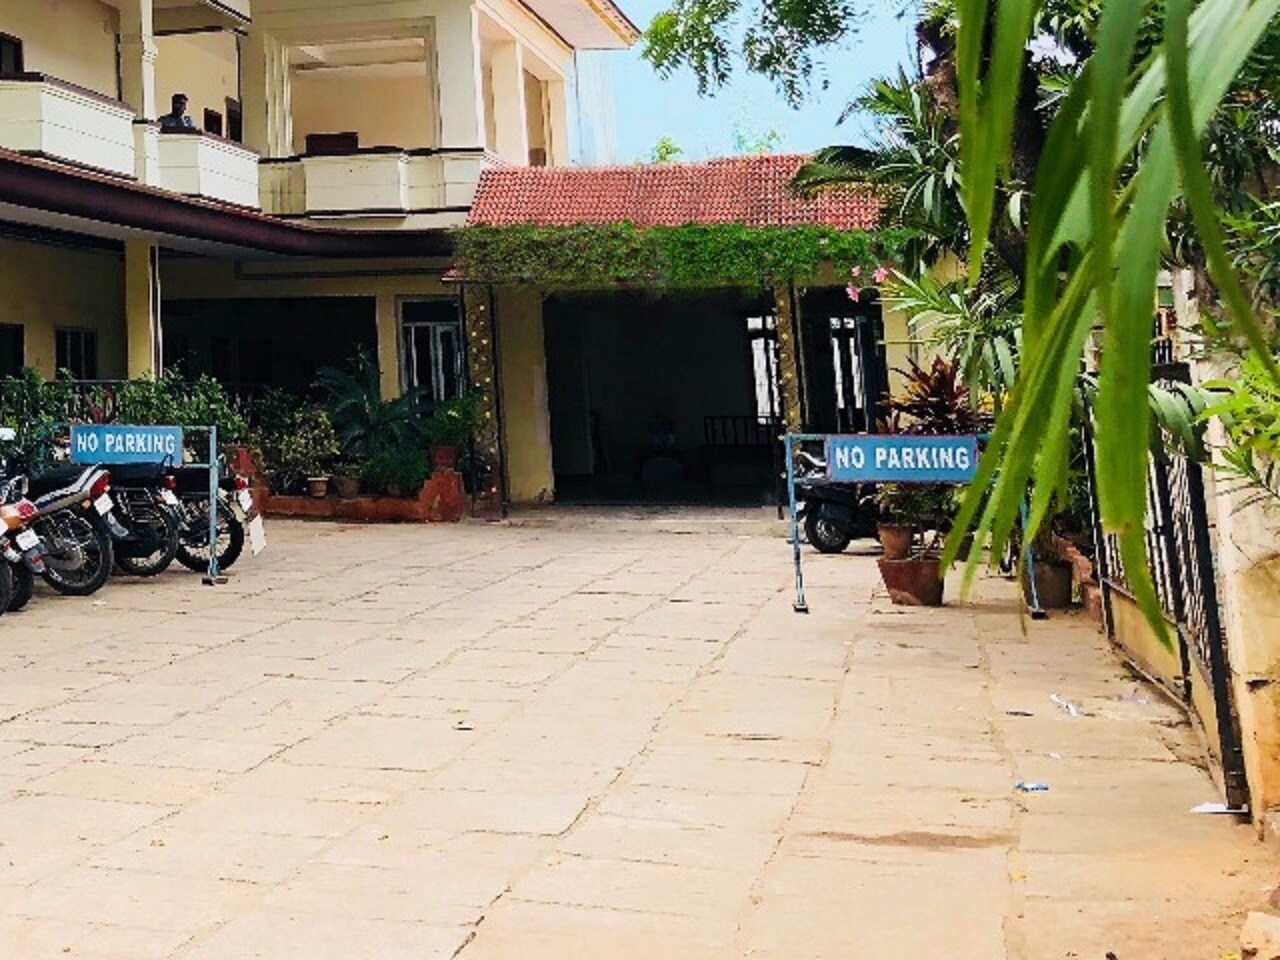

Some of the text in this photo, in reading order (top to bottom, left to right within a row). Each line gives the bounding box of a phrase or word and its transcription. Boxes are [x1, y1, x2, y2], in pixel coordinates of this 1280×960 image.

[77, 432, 175, 454] NO PARKING
[835, 446, 970, 470] NO PARKING
